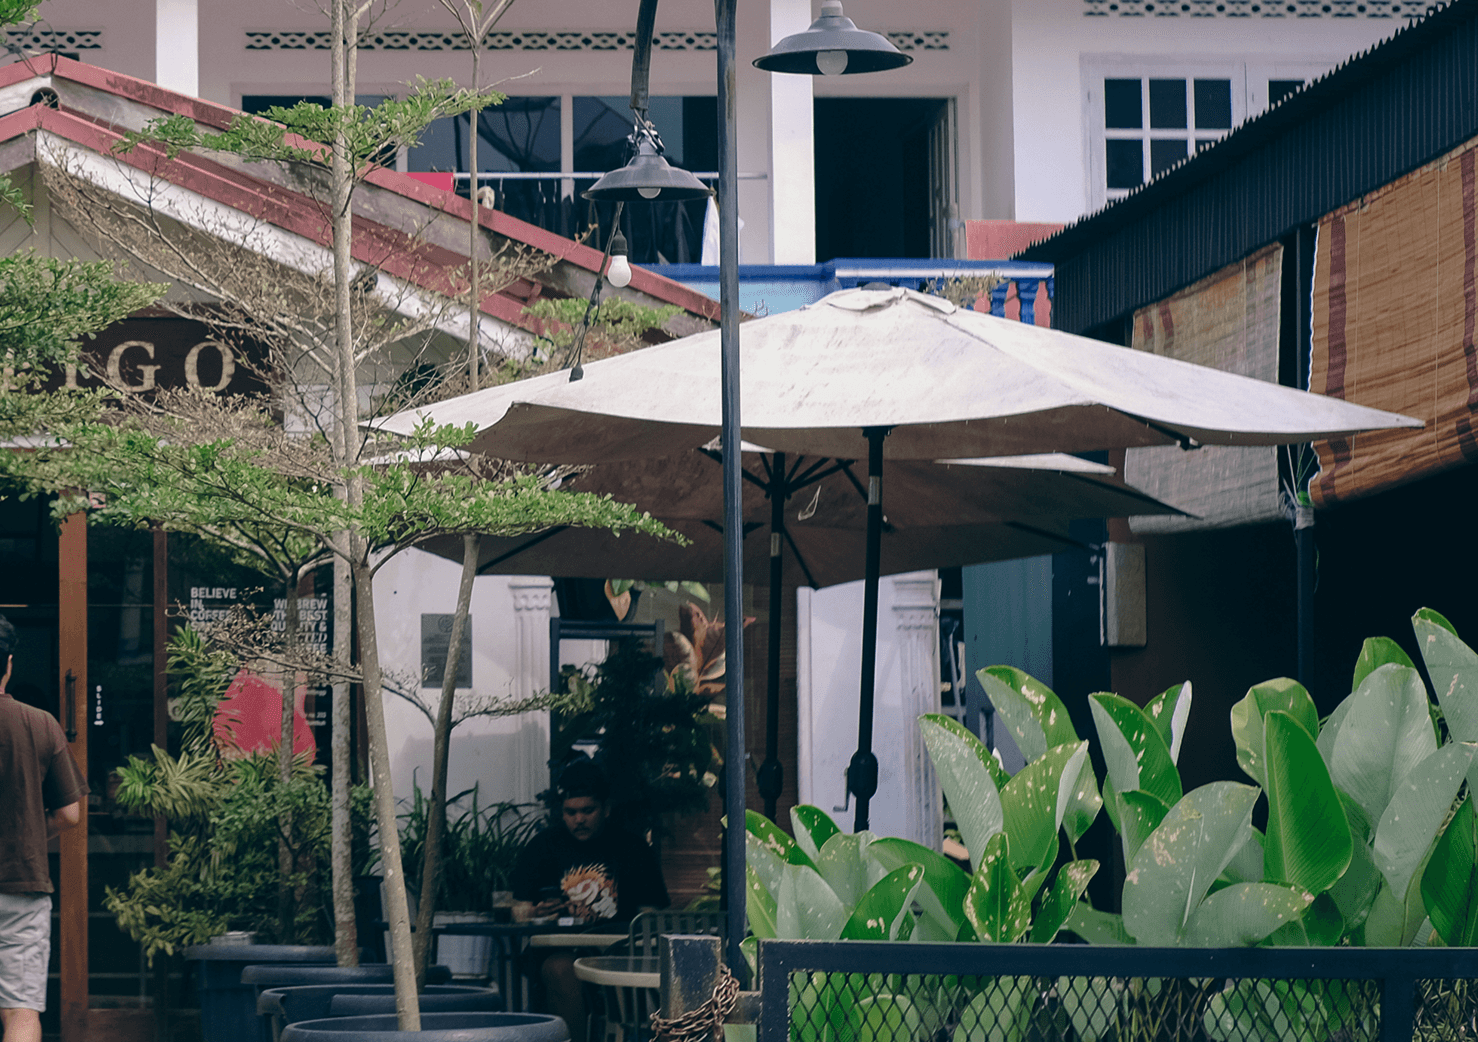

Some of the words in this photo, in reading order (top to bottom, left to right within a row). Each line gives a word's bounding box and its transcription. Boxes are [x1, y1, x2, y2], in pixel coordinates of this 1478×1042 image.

[190, 587, 237, 599] BELIEVE
[299, 610, 328, 621] BEST
[318, 621, 328, 632] &
